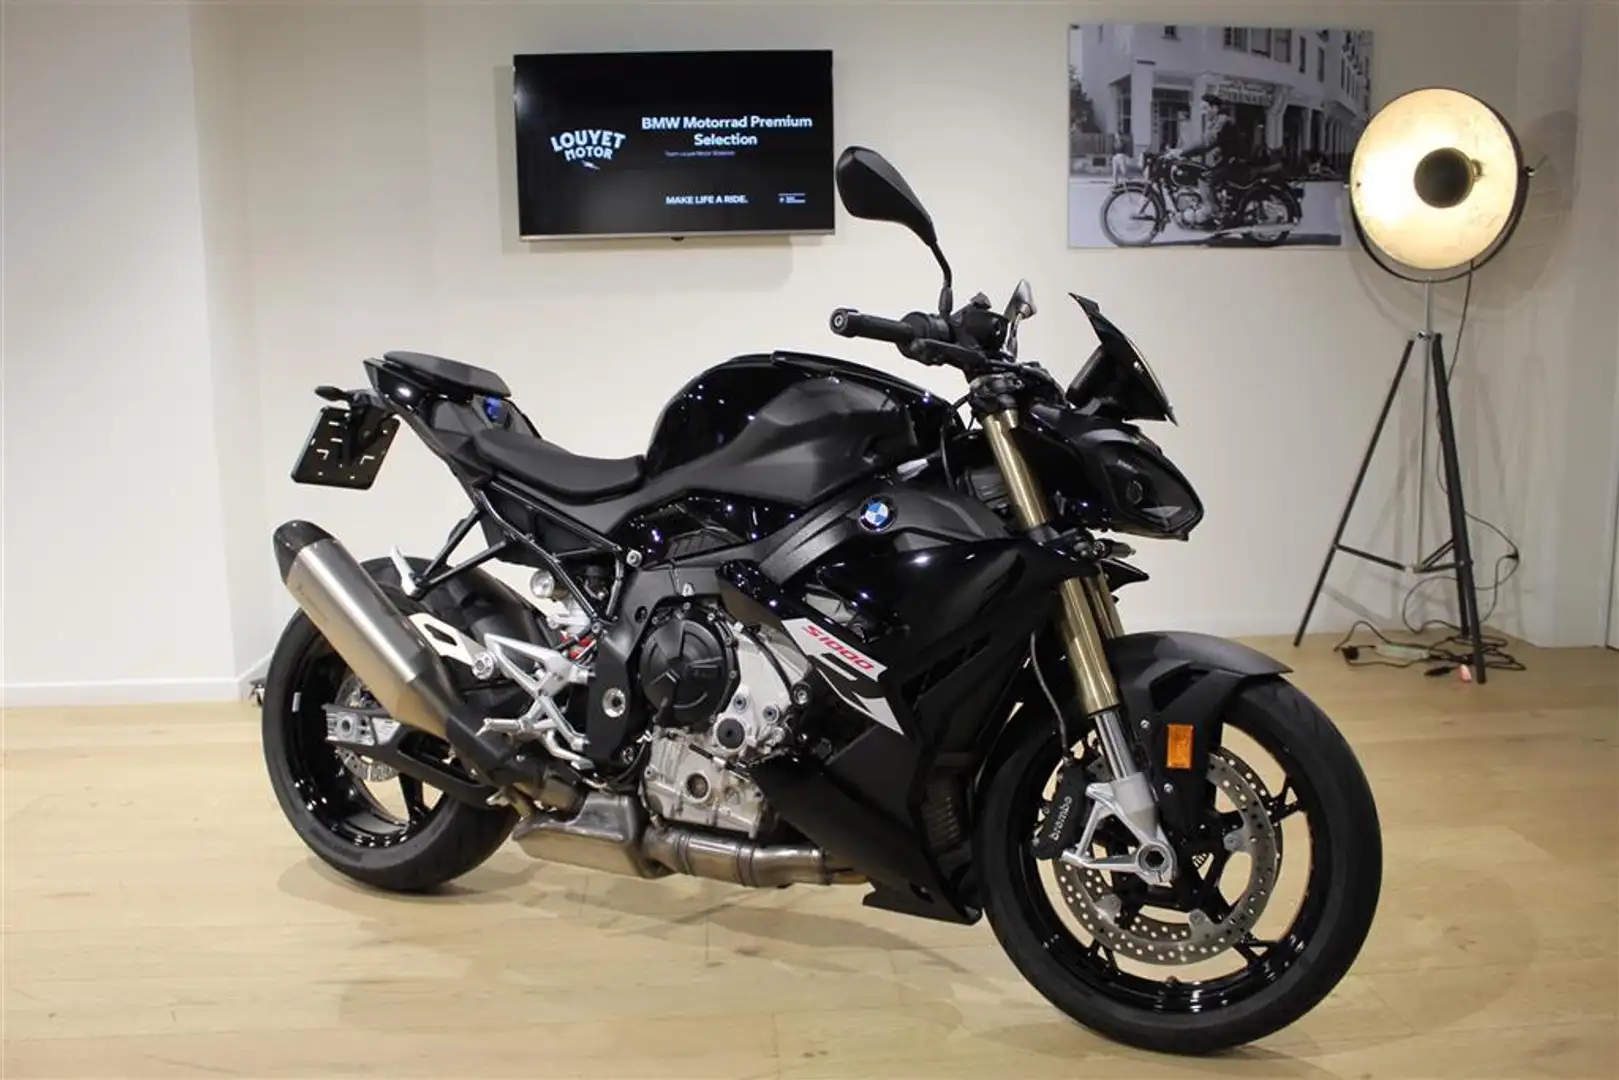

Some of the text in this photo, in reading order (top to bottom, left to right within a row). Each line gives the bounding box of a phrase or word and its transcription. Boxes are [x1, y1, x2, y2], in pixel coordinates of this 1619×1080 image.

[641, 114, 813, 130] BMW Motorrad Premium
[550, 129, 626, 152] LOUYET
[694, 133, 758, 146] Selection
[564, 145, 614, 161] MOTOR
[665, 196, 694, 205] MAKE
[695, 196, 714, 205] LIFE
[715, 195, 724, 204] A
[1048, 796, 1073, 841] brembo
